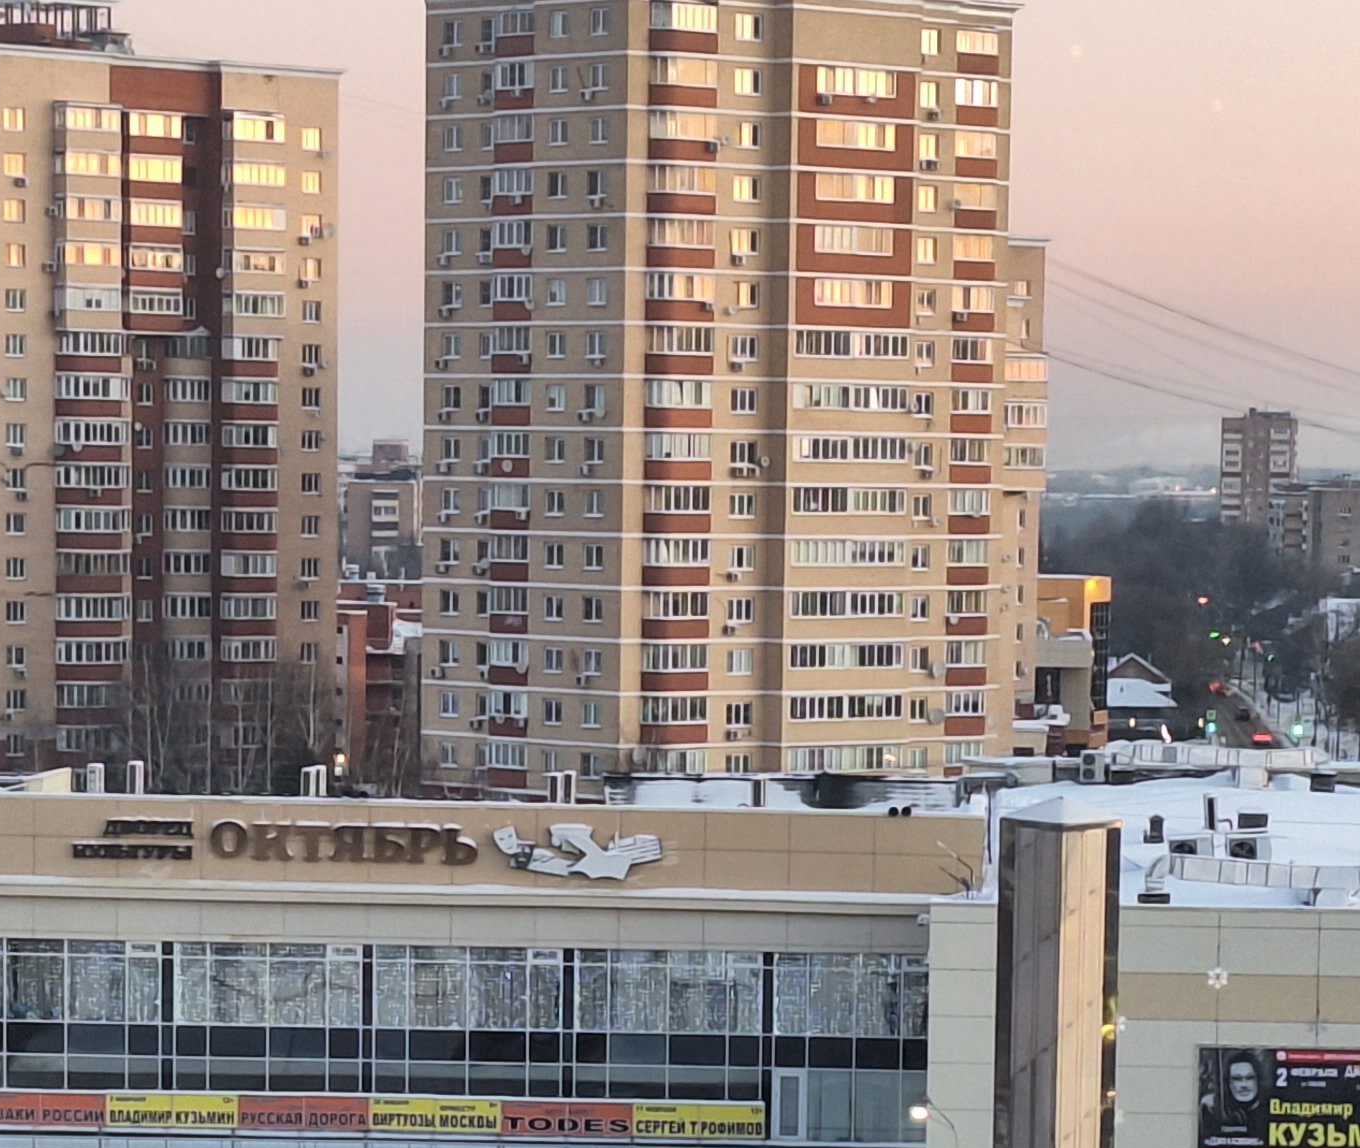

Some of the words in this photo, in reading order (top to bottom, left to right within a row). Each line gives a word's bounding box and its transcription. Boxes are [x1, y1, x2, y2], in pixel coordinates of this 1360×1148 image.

[211, 819, 478, 866] ОКТЯБРЬ
[1276, 1068, 1288, 1088] 2
[42, 1108, 104, 1123] РОССИИ
[109, 1109, 172, 1124] ВЛАДИМИР
[175, 1110, 235, 1125] КУЗЬМИН
[1269, 1098, 1354, 1120] Владимир
[241, 1111, 303, 1125] РУССКАЯ
[308, 1112, 367, 1128] ДОРОГА
[372, 1112, 437, 1128] ВИРТУОЗЫ
[439, 1114, 497, 1129] МОСКВЫ
[503, 1115, 630, 1133] TODES
[635, 1118, 686, 1135] СЕРГЕЙ
